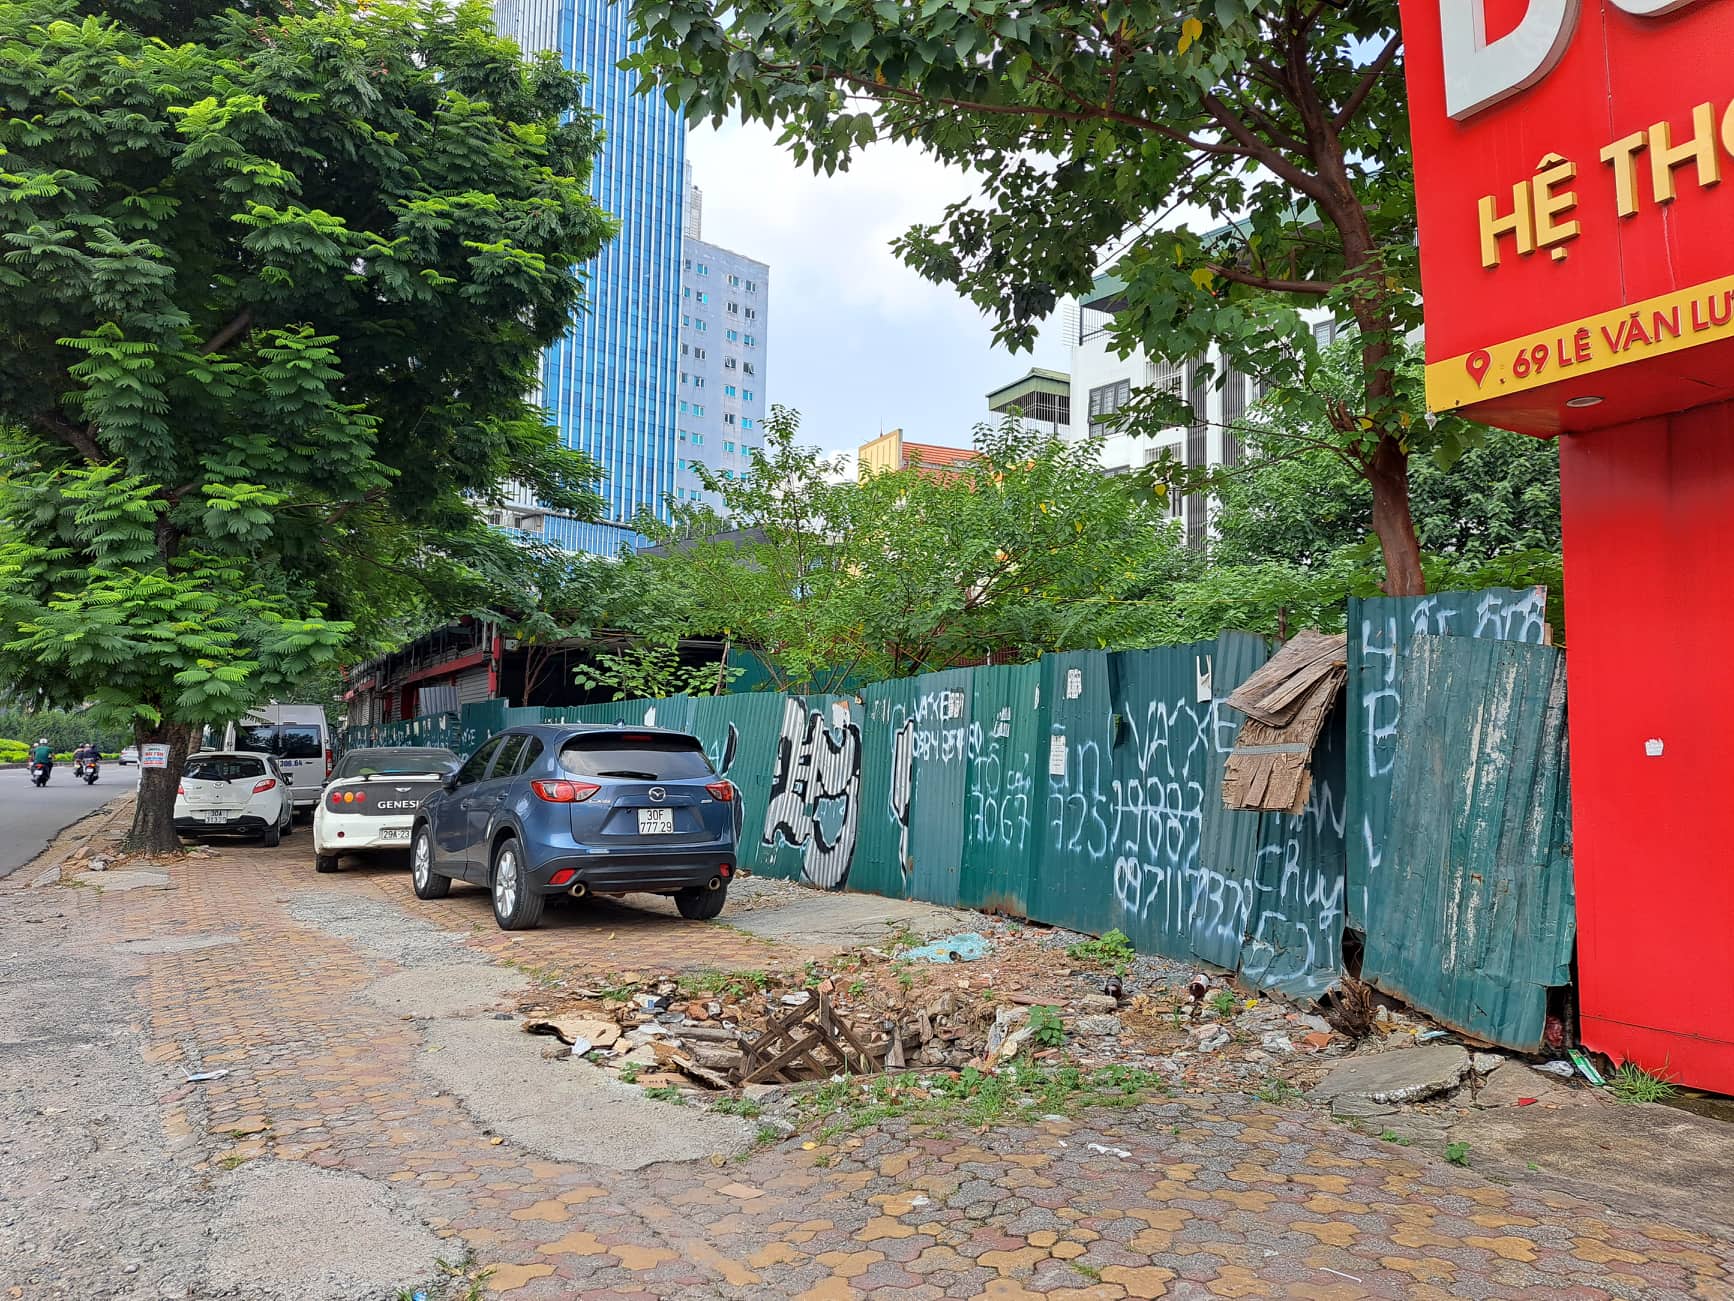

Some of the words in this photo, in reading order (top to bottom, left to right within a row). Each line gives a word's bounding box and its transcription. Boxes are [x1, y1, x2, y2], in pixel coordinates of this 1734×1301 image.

[1478, 152, 1581, 268] HỆ
[1600, 97, 1734, 218] TH
[1512, 343, 1550, 378] 69
[1557, 326, 1592, 368] LÊ
[1600, 310, 1681, 354] VĂN
[377, 800, 420, 810] GENESI
[647, 810, 664, 820] 30F
